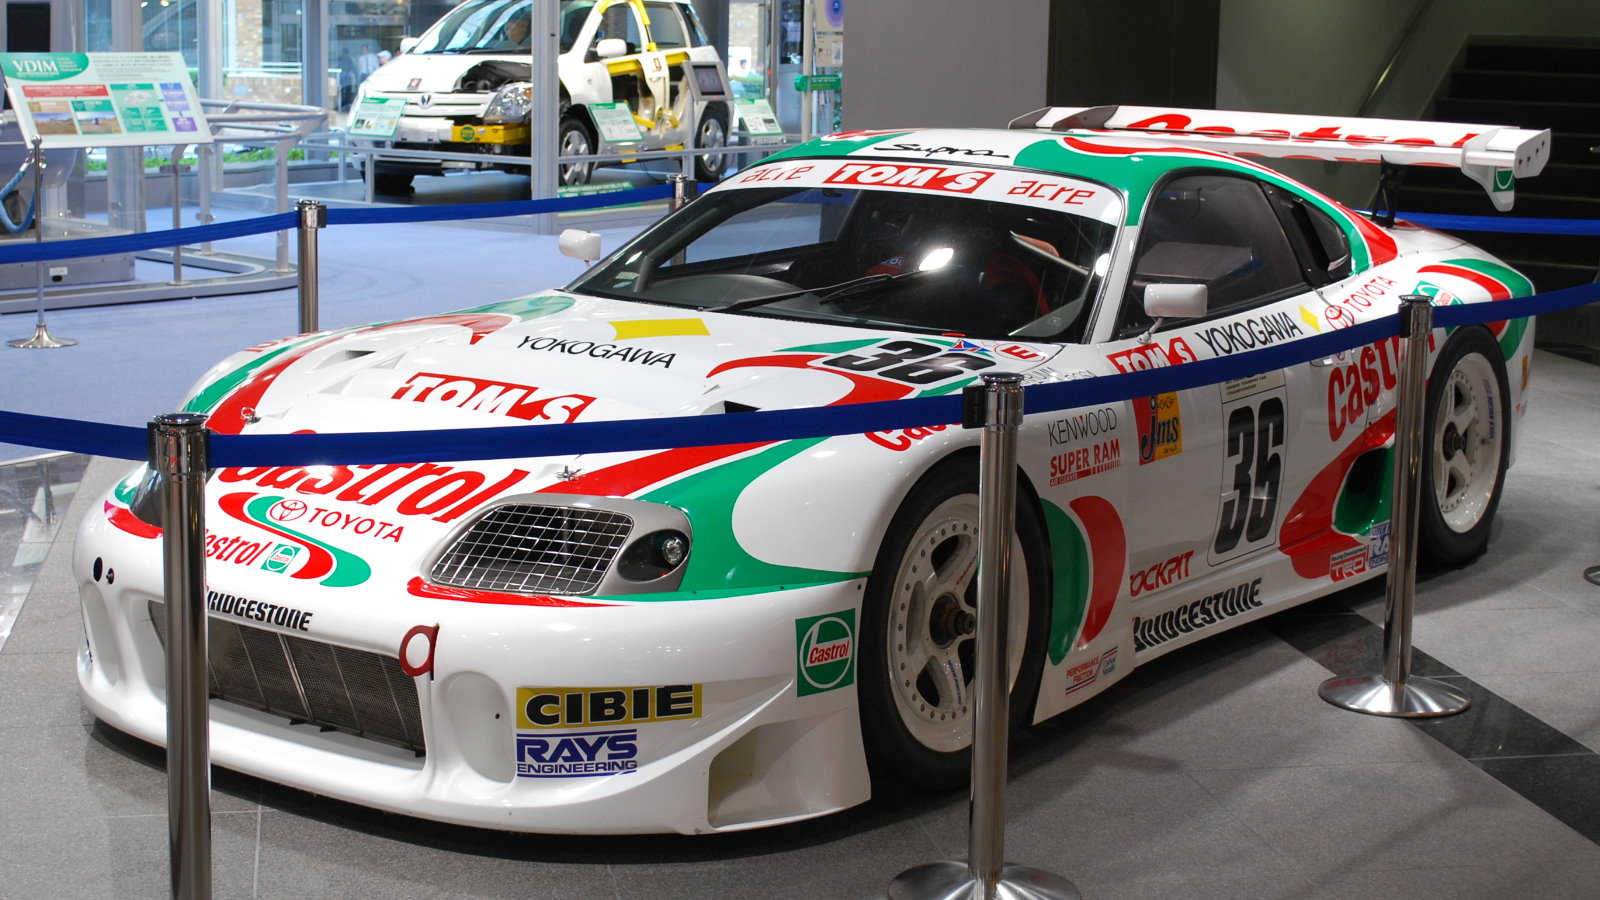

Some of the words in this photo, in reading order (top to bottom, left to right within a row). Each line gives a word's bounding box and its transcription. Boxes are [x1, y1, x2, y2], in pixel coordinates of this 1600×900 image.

[12, 60, 59, 73] VDIM
[873, 143, 1010, 159] Supra
[740, 165, 815, 184] acre
[828, 164, 990, 192] TOM'S
[1007, 180, 1096, 205] acre
[1343, 276, 1398, 313] TOYOTA
[516, 335, 677, 369] YOKOGAWA
[1000, 345, 1040, 360] E
[1196, 312, 1303, 356] YOKOGAWA
[822, 341, 997, 385] 36
[1048, 408, 1118, 447] KENWOOD
[1050, 447, 1090, 478] SUPER
[1093, 438, 1121, 465] RAM
[1214, 397, 1284, 555] 36
[308, 507, 405, 543] TOYOTA
[1130, 550, 1195, 597] OCKPIT
[1331, 556, 1365, 578] TRD
[207, 590, 313, 631] RIDGESTONE
[809, 640, 851, 666] Castrol
[525, 684, 694, 726] CIBIE
[517, 735, 638, 763] RAYS
[517, 760, 638, 774] ENGINEERING
